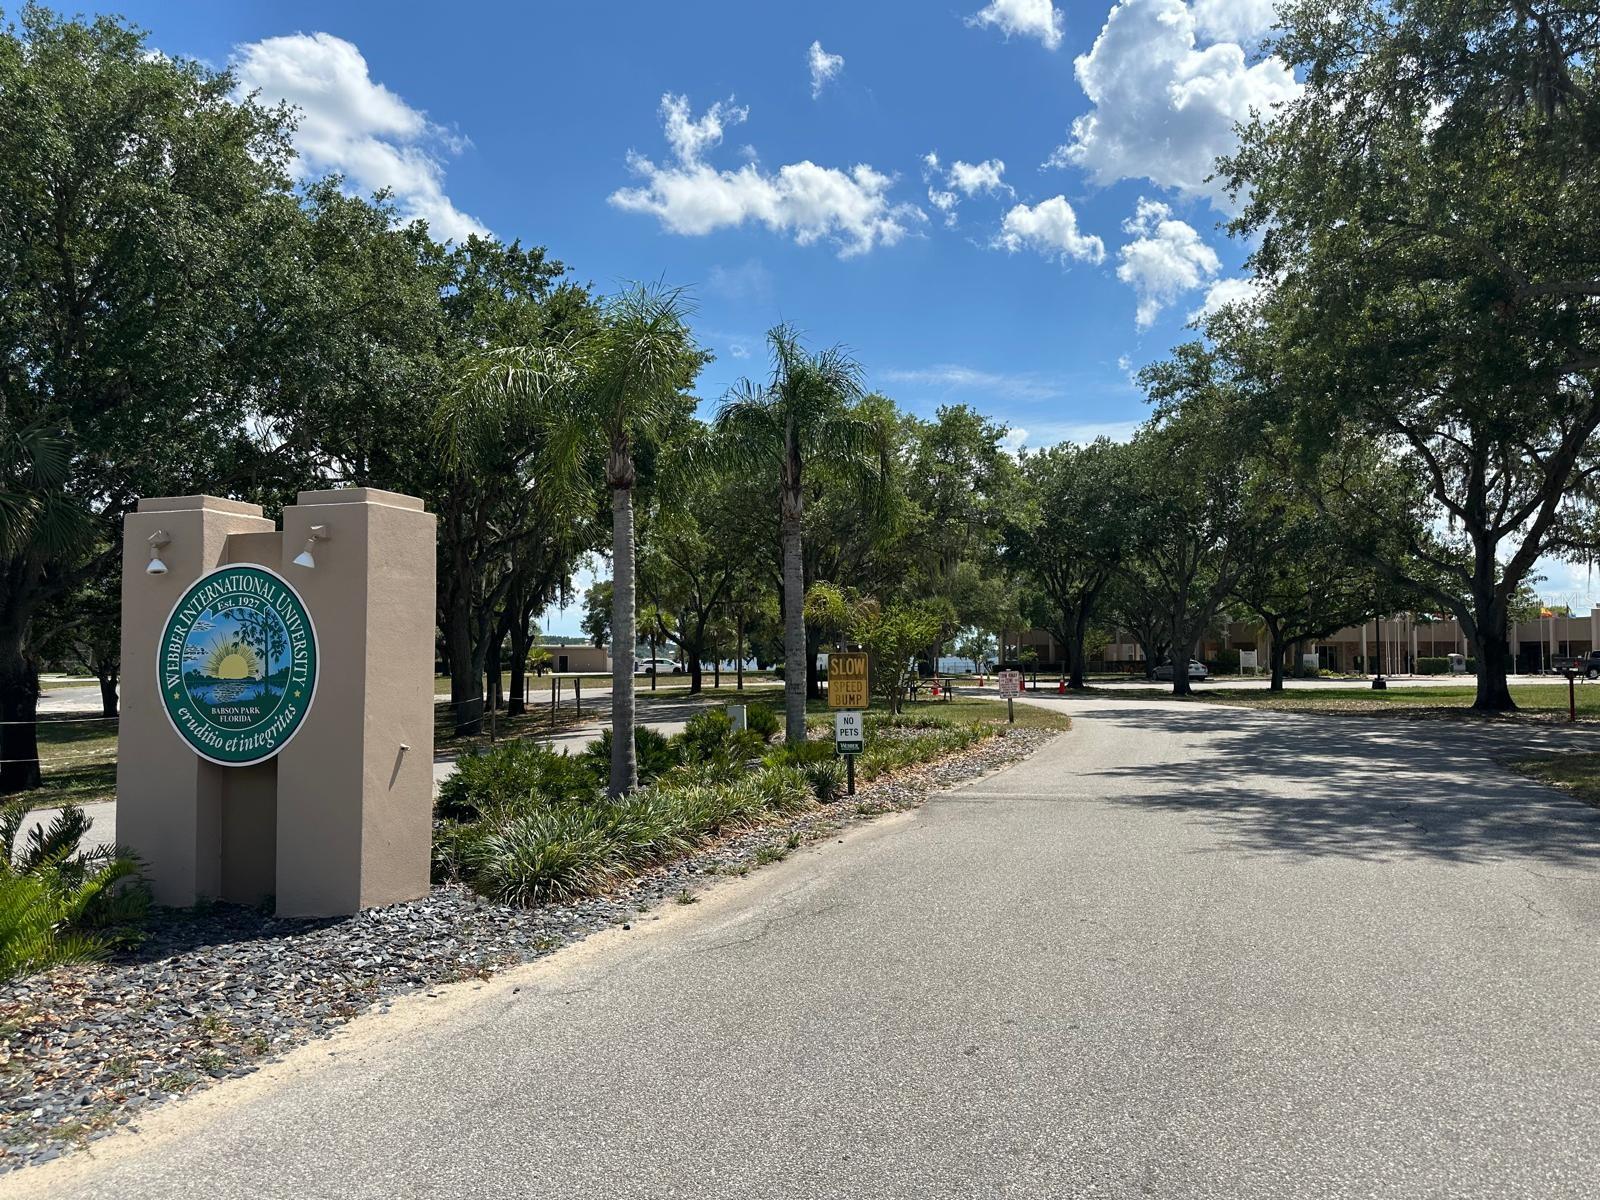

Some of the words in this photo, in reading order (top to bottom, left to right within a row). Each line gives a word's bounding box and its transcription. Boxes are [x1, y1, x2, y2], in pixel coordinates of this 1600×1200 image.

[217, 599, 236, 611] Est.
[238, 596, 260, 608] 1927
[166, 625, 188, 690] WEBBER
[179, 575, 277, 626] INTERNATIONAL
[276, 592, 309, 687] UNIVERSITY
[830, 658, 865, 676] SLOW
[833, 681, 863, 693] SPEED
[835, 694, 862, 706] BUMP
[211, 706, 240, 715] BABSON
[240, 706, 261, 715] PARK
[219, 715, 252, 723] FLORIDA
[843, 716, 854, 725] NO
[178, 706, 223, 749] eruditio
[225, 736, 237, 751] et
[239, 703, 297, 752] integritas
[840, 728, 859, 737] PETS
